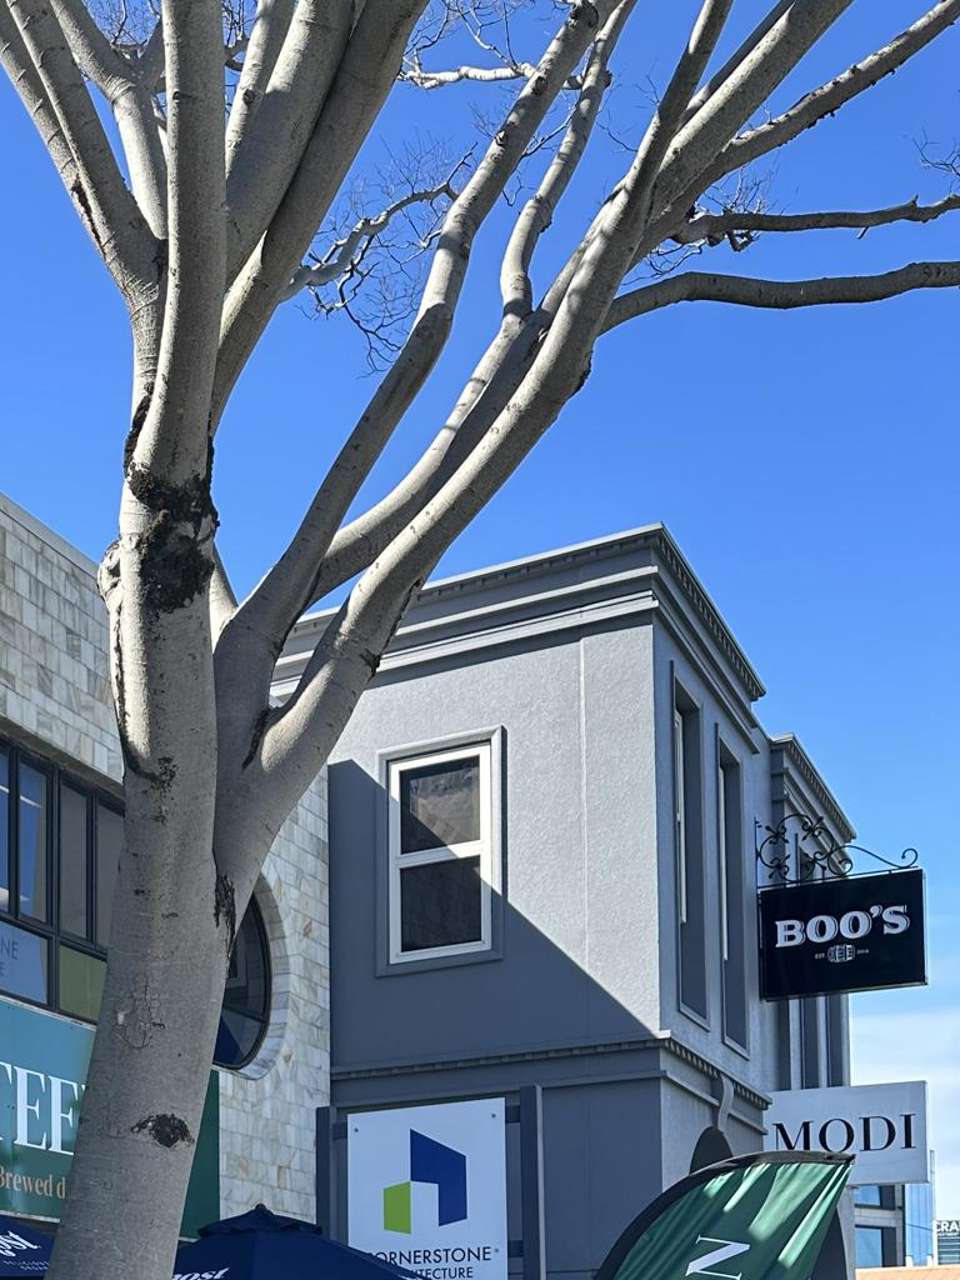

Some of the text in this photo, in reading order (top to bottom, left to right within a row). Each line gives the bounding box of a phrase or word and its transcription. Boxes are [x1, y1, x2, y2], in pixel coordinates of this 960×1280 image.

[774, 903, 911, 948] BOO'S
[772, 1113, 917, 1153] MODI
[369, 1246, 492, 1267] ORNERSTONE
